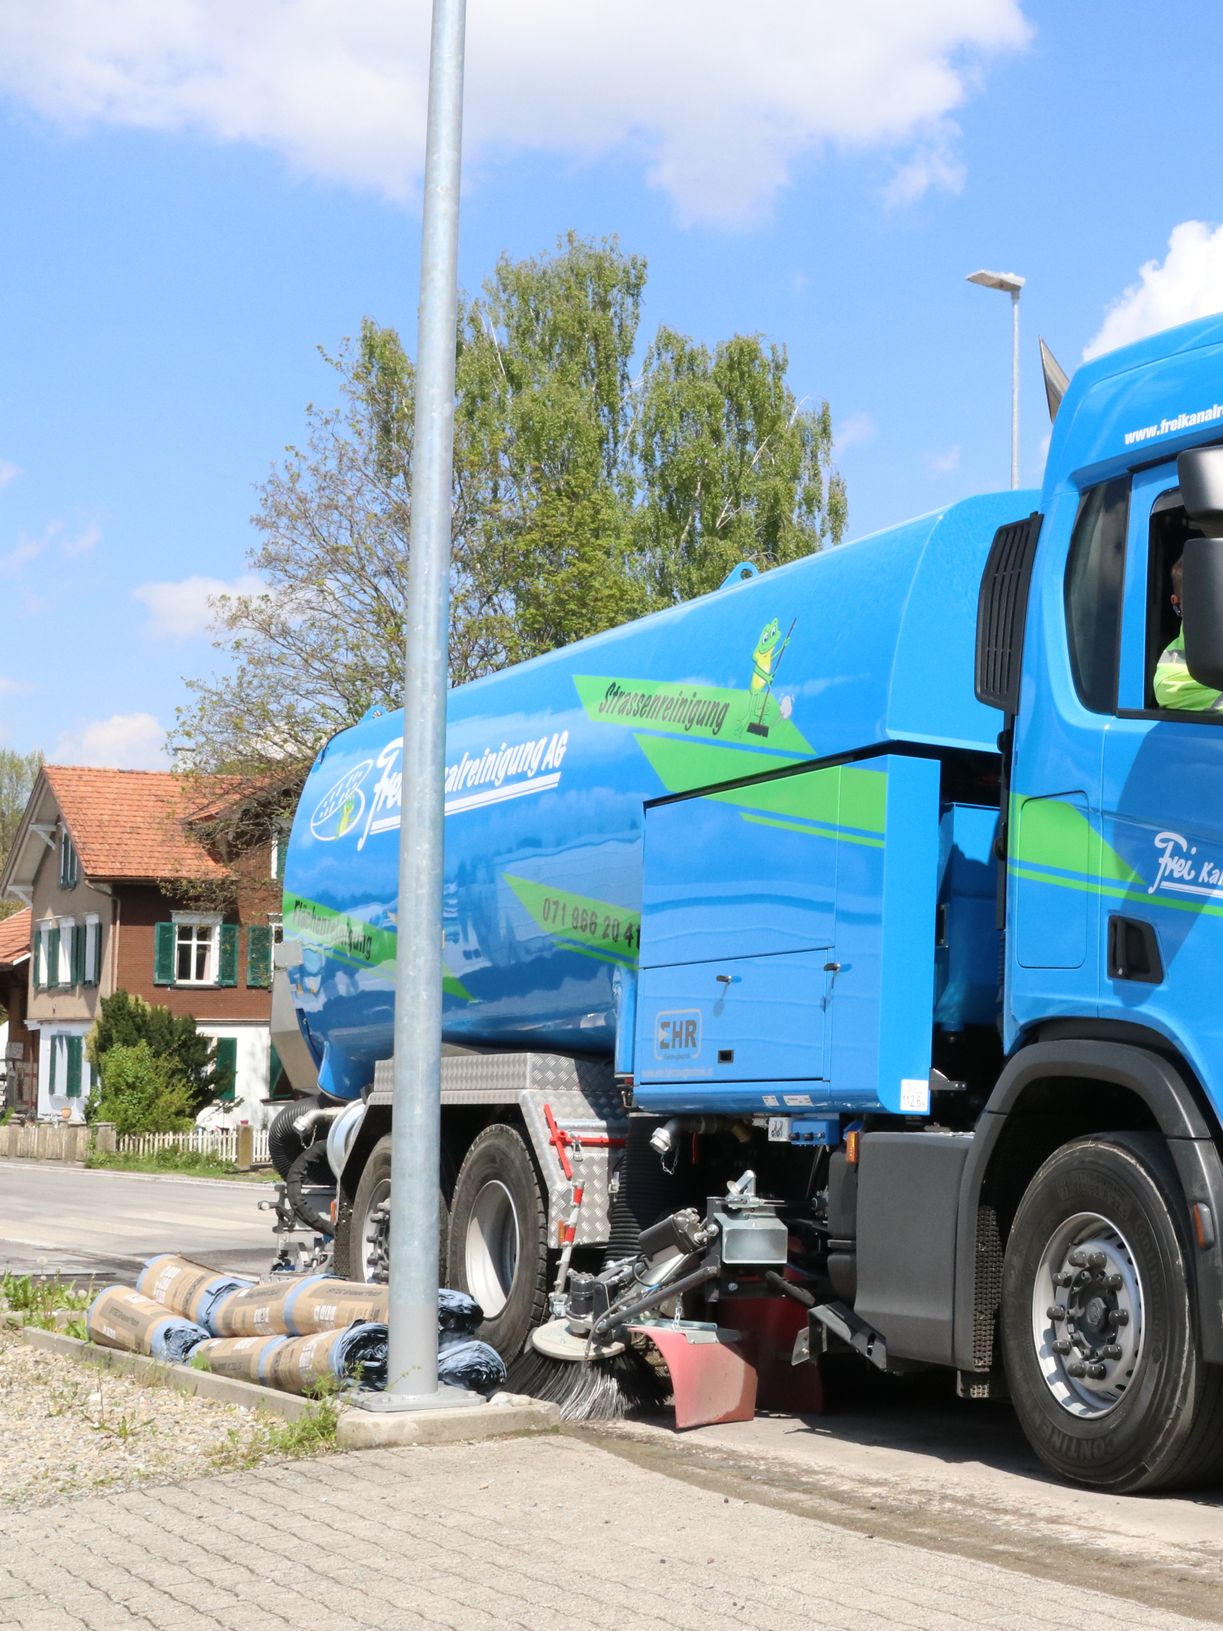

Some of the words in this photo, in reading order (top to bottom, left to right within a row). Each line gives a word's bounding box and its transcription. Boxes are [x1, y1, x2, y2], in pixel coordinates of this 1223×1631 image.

[599, 681, 730, 735] Strassenreinigung
[357, 736, 404, 851] Fre
[445, 737, 548, 795] alreinigung
[541, 730, 568, 770] AG
[1148, 831, 1197, 894] Frei
[543, 898, 567, 926] 071
[572, 905, 598, 935] 966
[602, 915, 620, 943] 20
